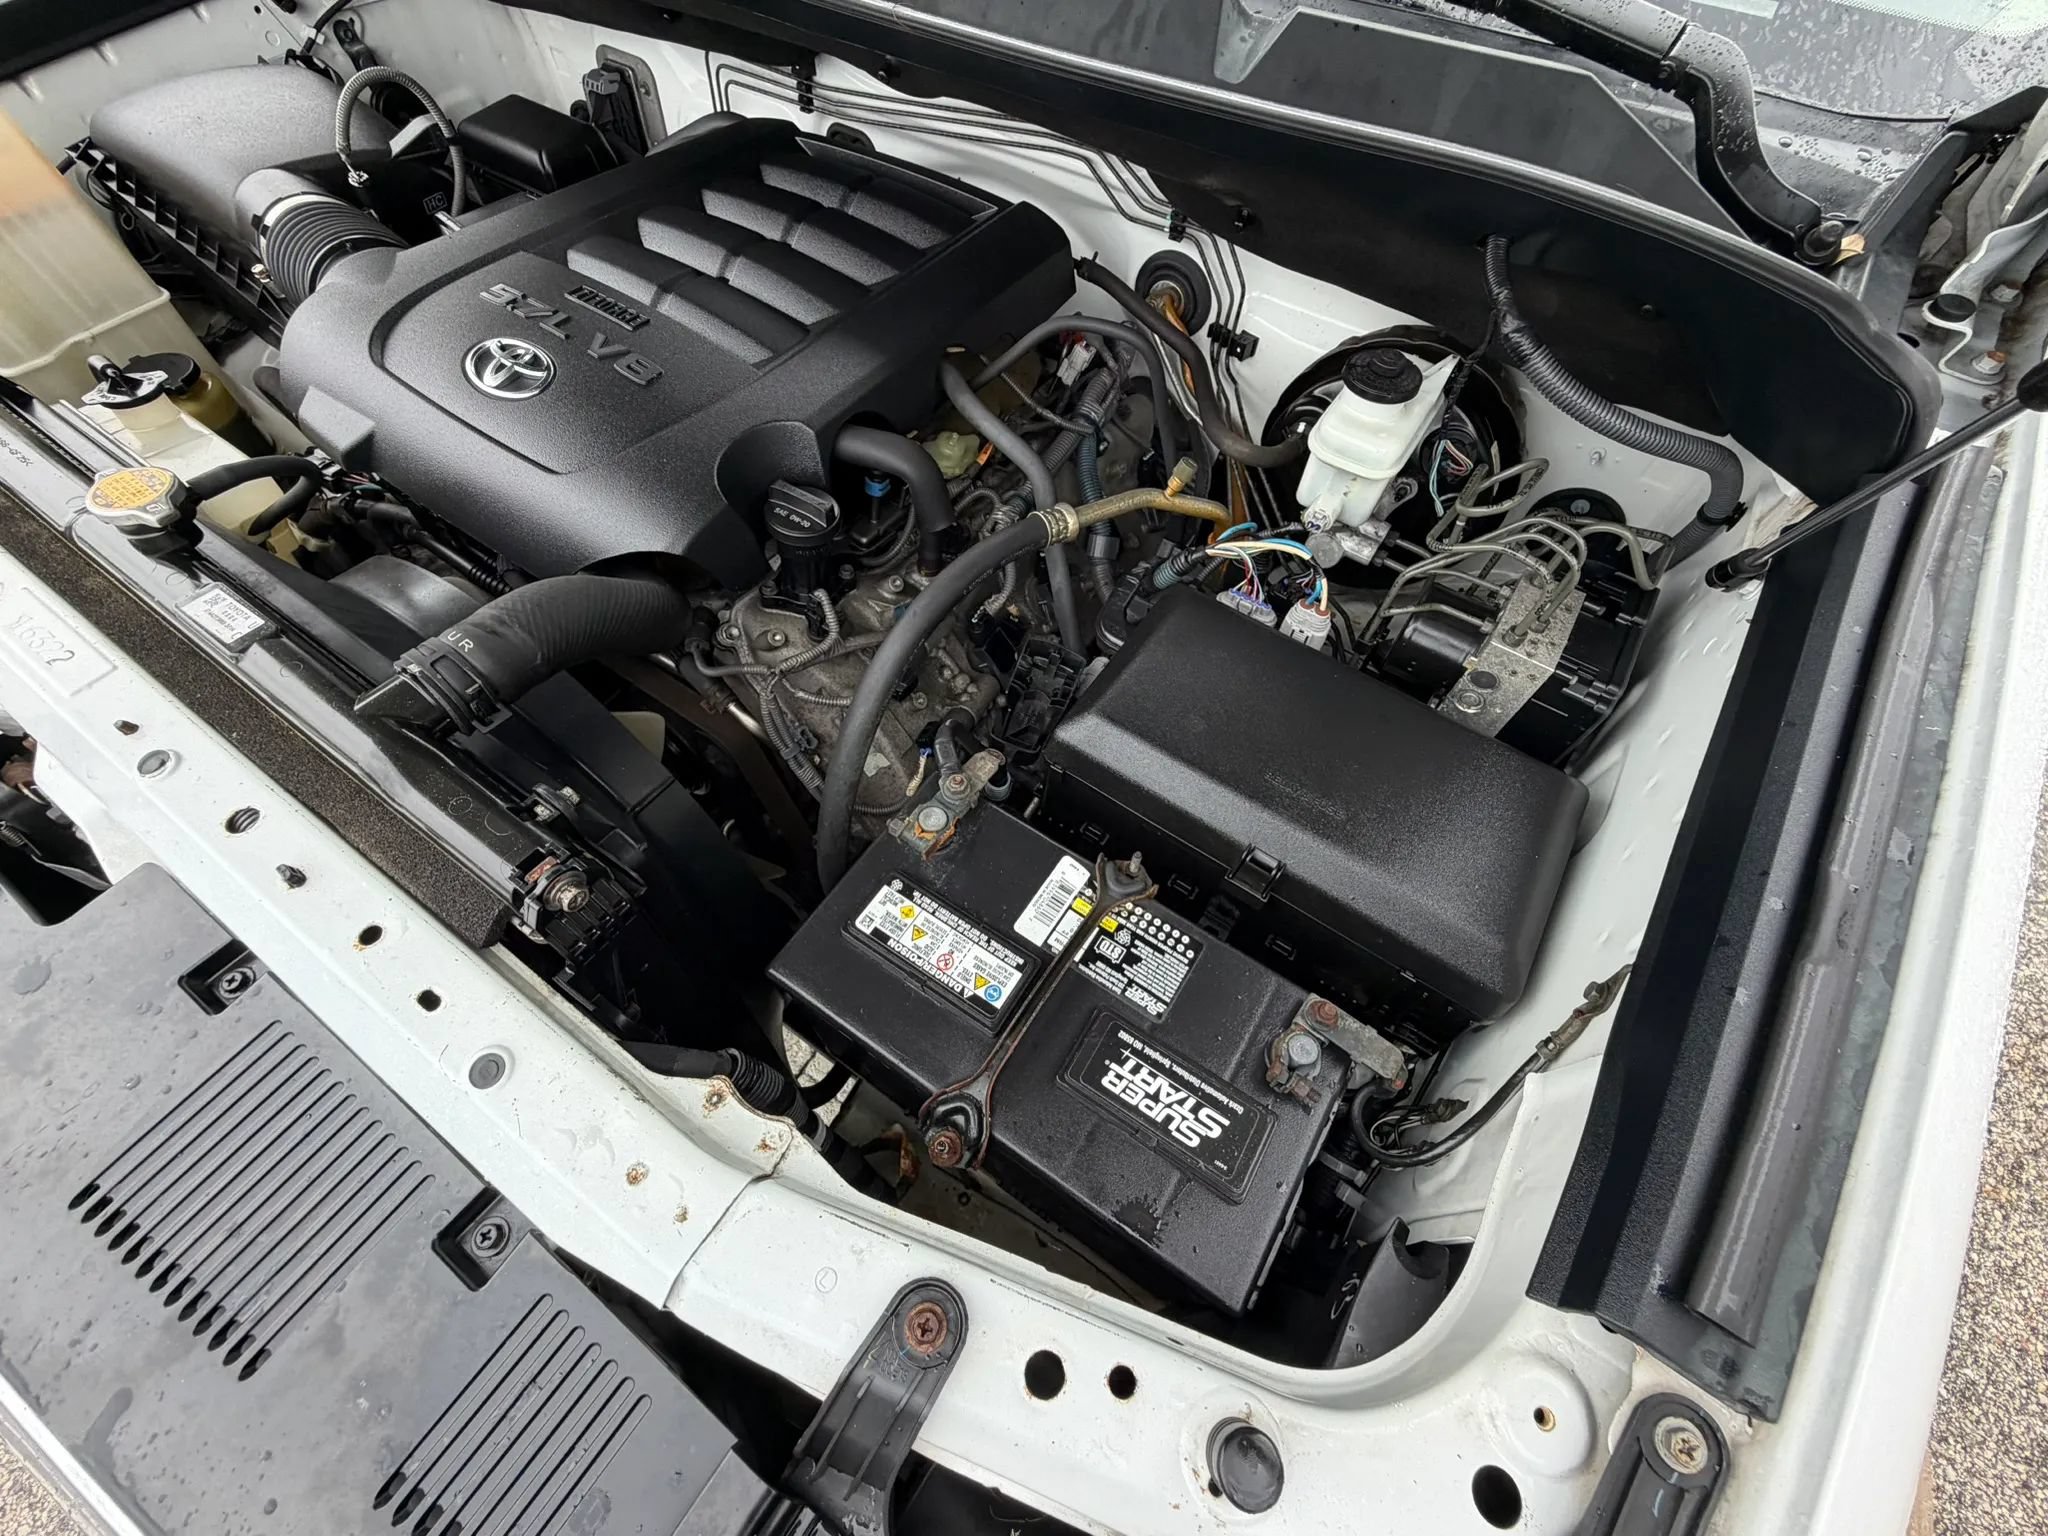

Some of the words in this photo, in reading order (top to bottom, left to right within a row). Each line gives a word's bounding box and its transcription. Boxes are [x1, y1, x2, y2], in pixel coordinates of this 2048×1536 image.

[480, 283, 568, 340] 5.7L
[587, 332, 664, 386] V8
[789, 514, 811, 528] 0W-20
[225, 602, 251, 621] TOYOTA
[447, 630, 474, 652] UR
[1099, 940, 1121, 958] STD
[888, 939, 962, 991] DANGER/POISON
[1125, 989, 1158, 1015] SUPER
[1128, 984, 1166, 1012] START
[1132, 1039, 1143, 1050] MO
[1110, 1056, 1228, 1137] START
[1200, 1082, 1229, 1104] Automotive
[1102, 1071, 1206, 1146] SUPER
[1228, 1100, 1244, 1114] Ozark
